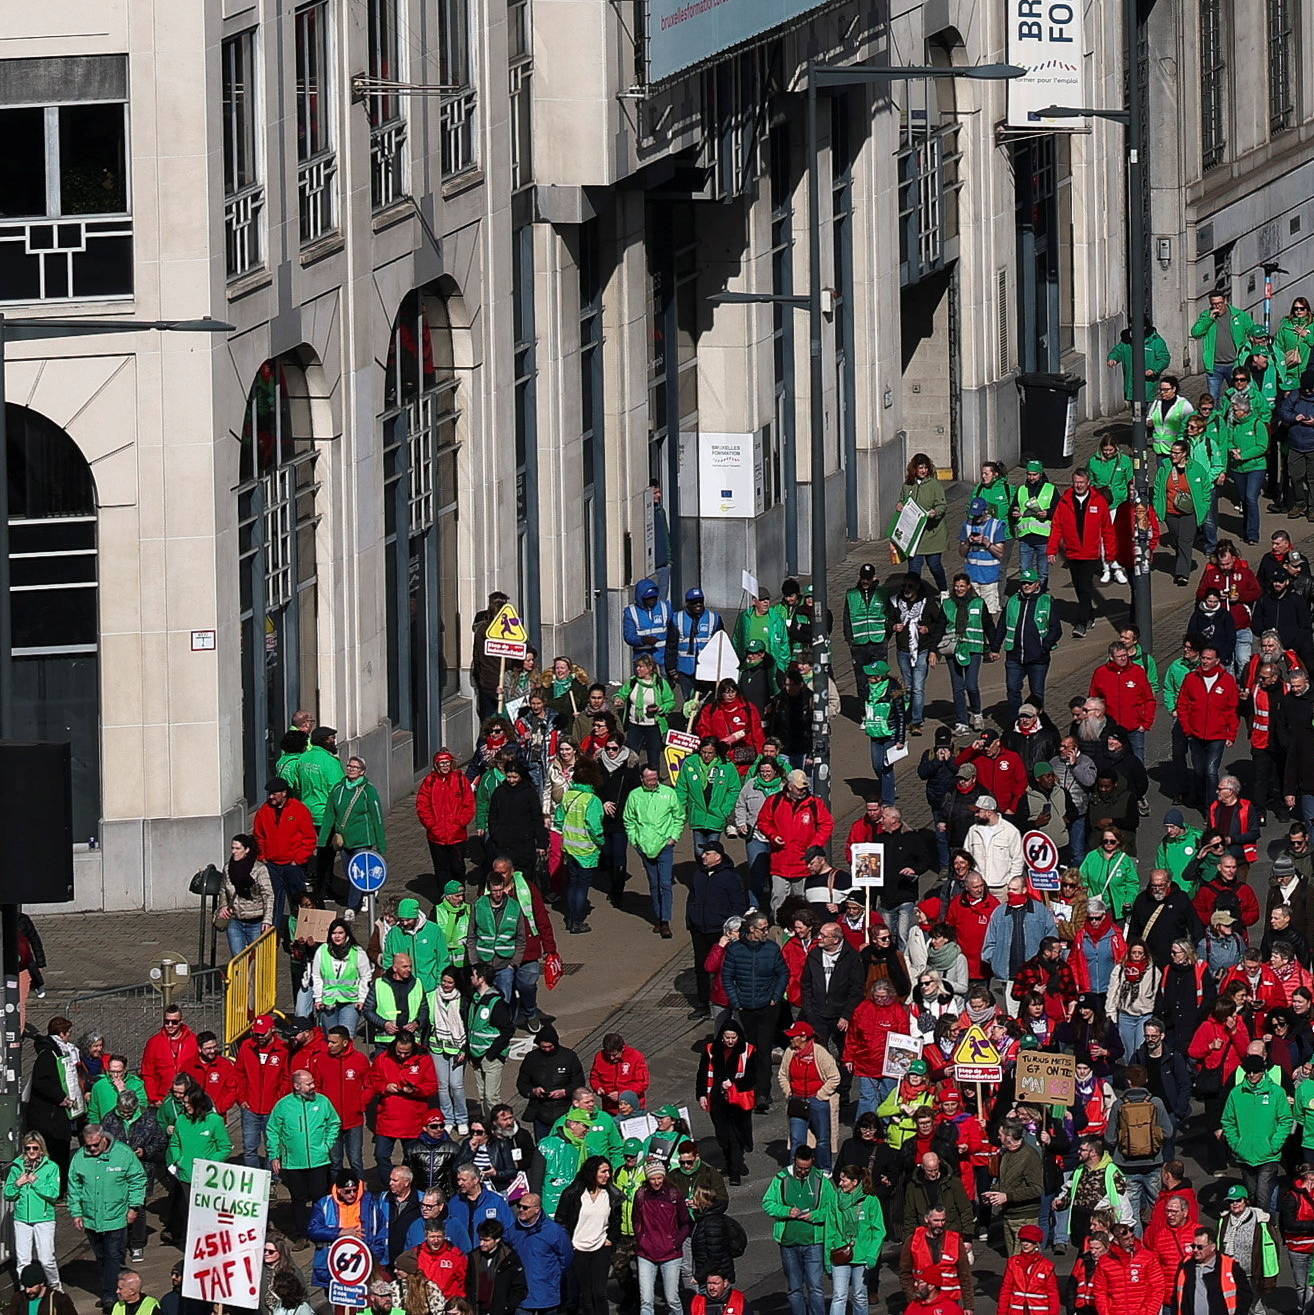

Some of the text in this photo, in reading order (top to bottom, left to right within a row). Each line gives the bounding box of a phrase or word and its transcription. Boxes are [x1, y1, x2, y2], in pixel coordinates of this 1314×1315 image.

[1030, 844, 1049, 861] 67
[1022, 1055, 1033, 1063] TU
[1051, 1057, 1072, 1065] METS
[1027, 1064, 1073, 1077] 67 ON TE
[1021, 1077, 1071, 1095] MAI 68
[195, 1193, 261, 1218] EN CLASSE
[193, 1230, 232, 1260] 45H
[336, 1252, 362, 1273] 67
[194, 1261, 236, 1301] TAF
